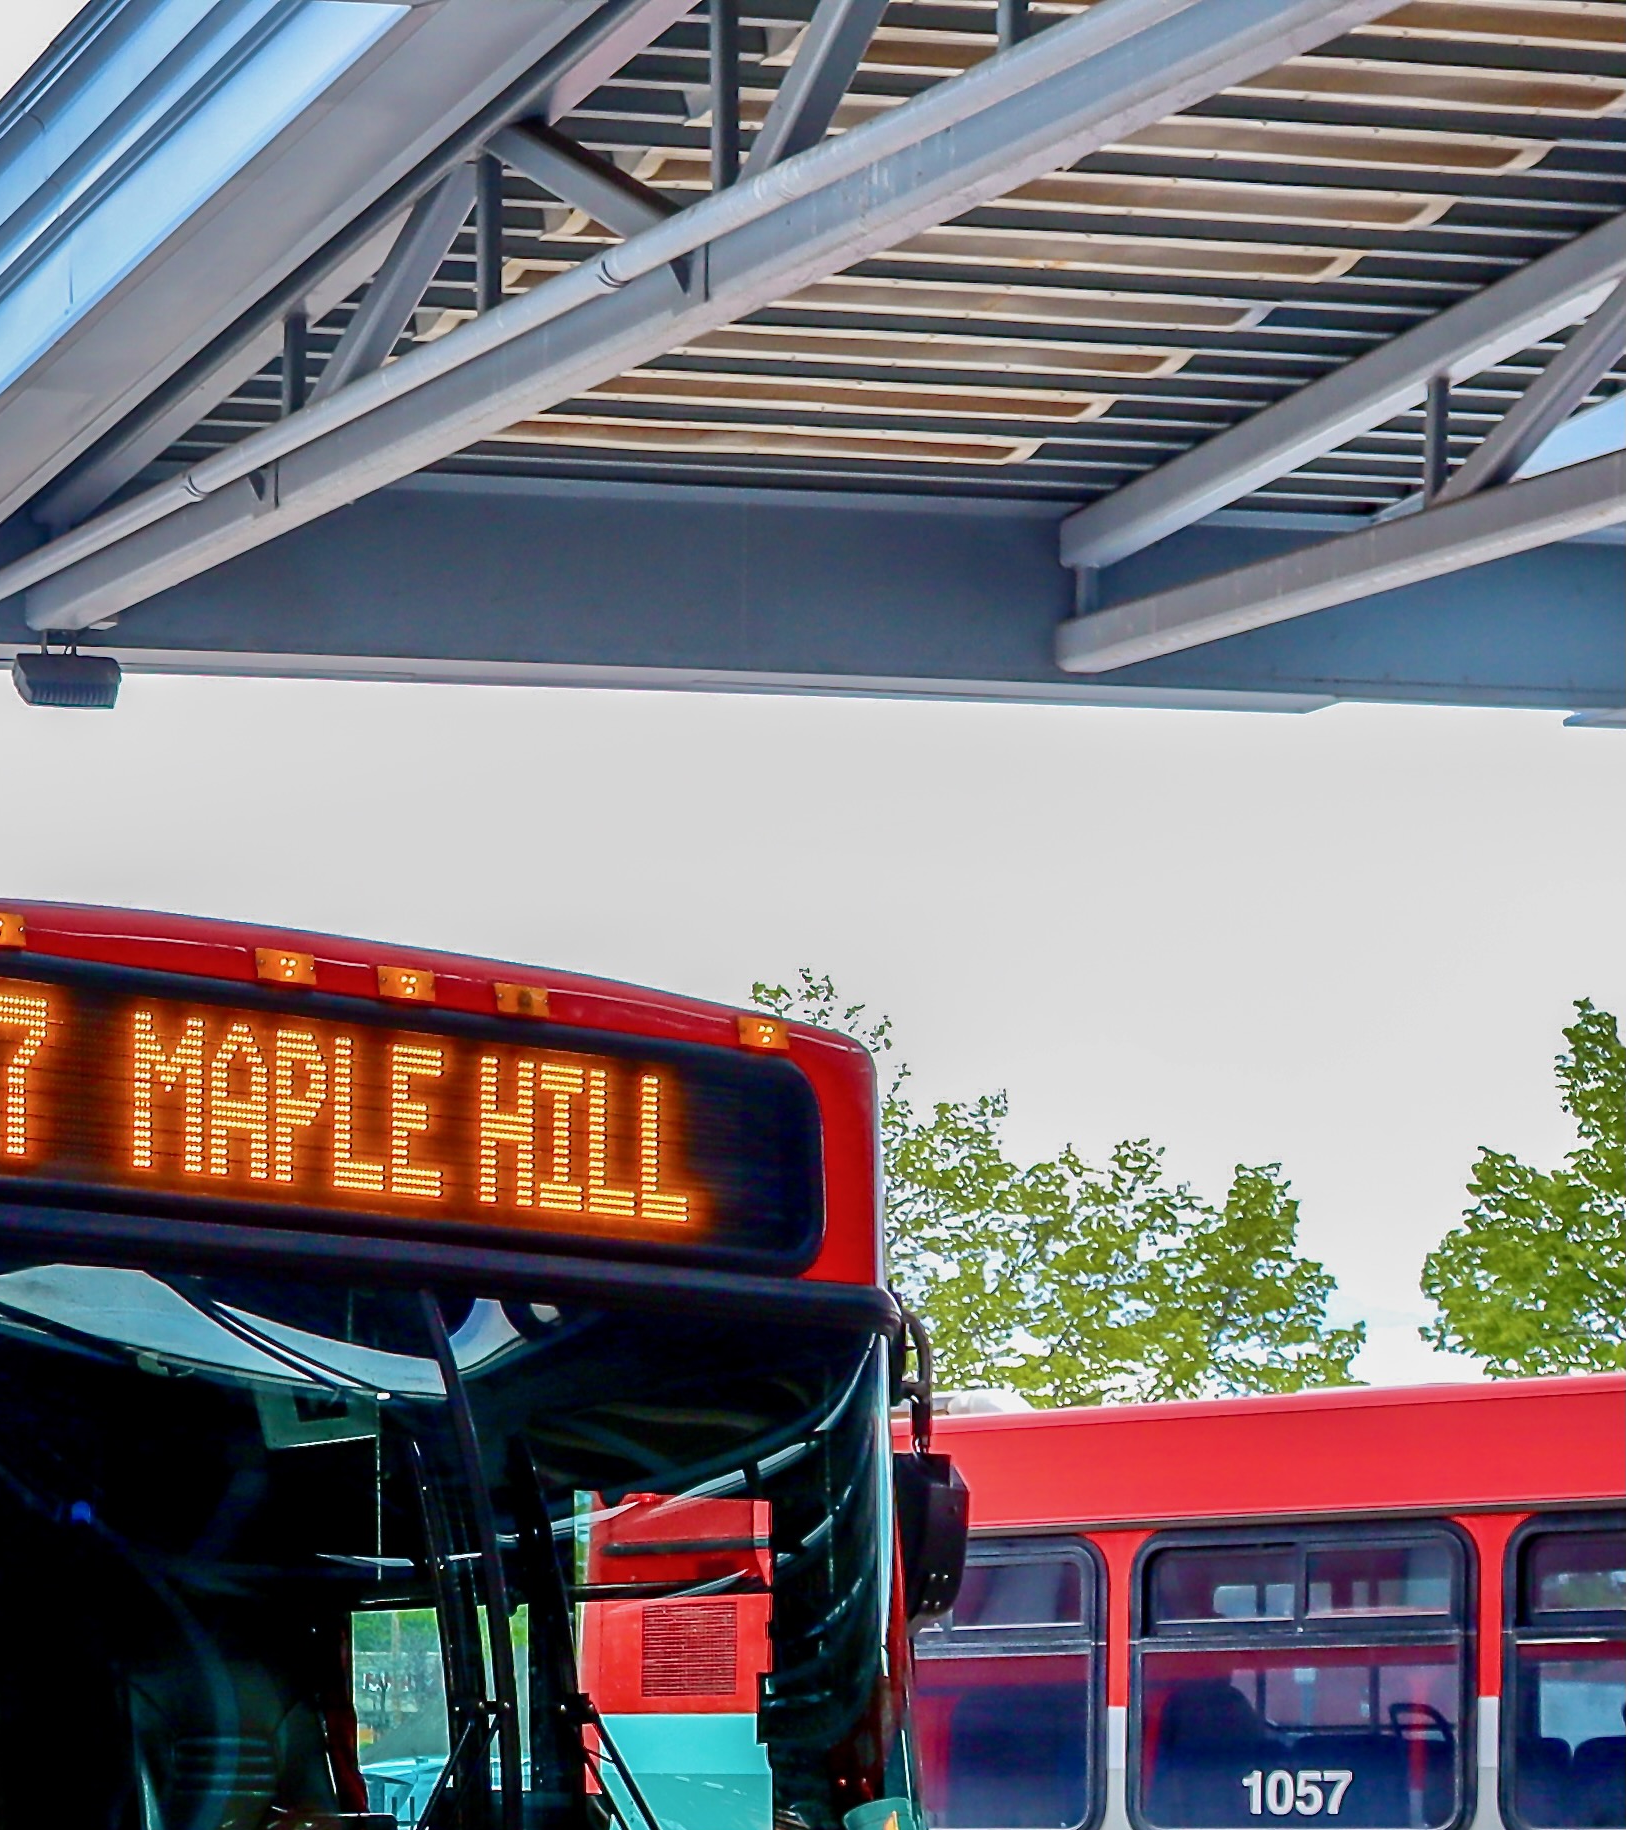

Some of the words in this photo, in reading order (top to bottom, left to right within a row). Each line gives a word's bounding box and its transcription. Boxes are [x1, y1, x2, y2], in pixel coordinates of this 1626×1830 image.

[132, 1010, 445, 1198] MAPLE
[479, 1055, 690, 1223] HILL
[1241, 1769, 1353, 1816] 1057
